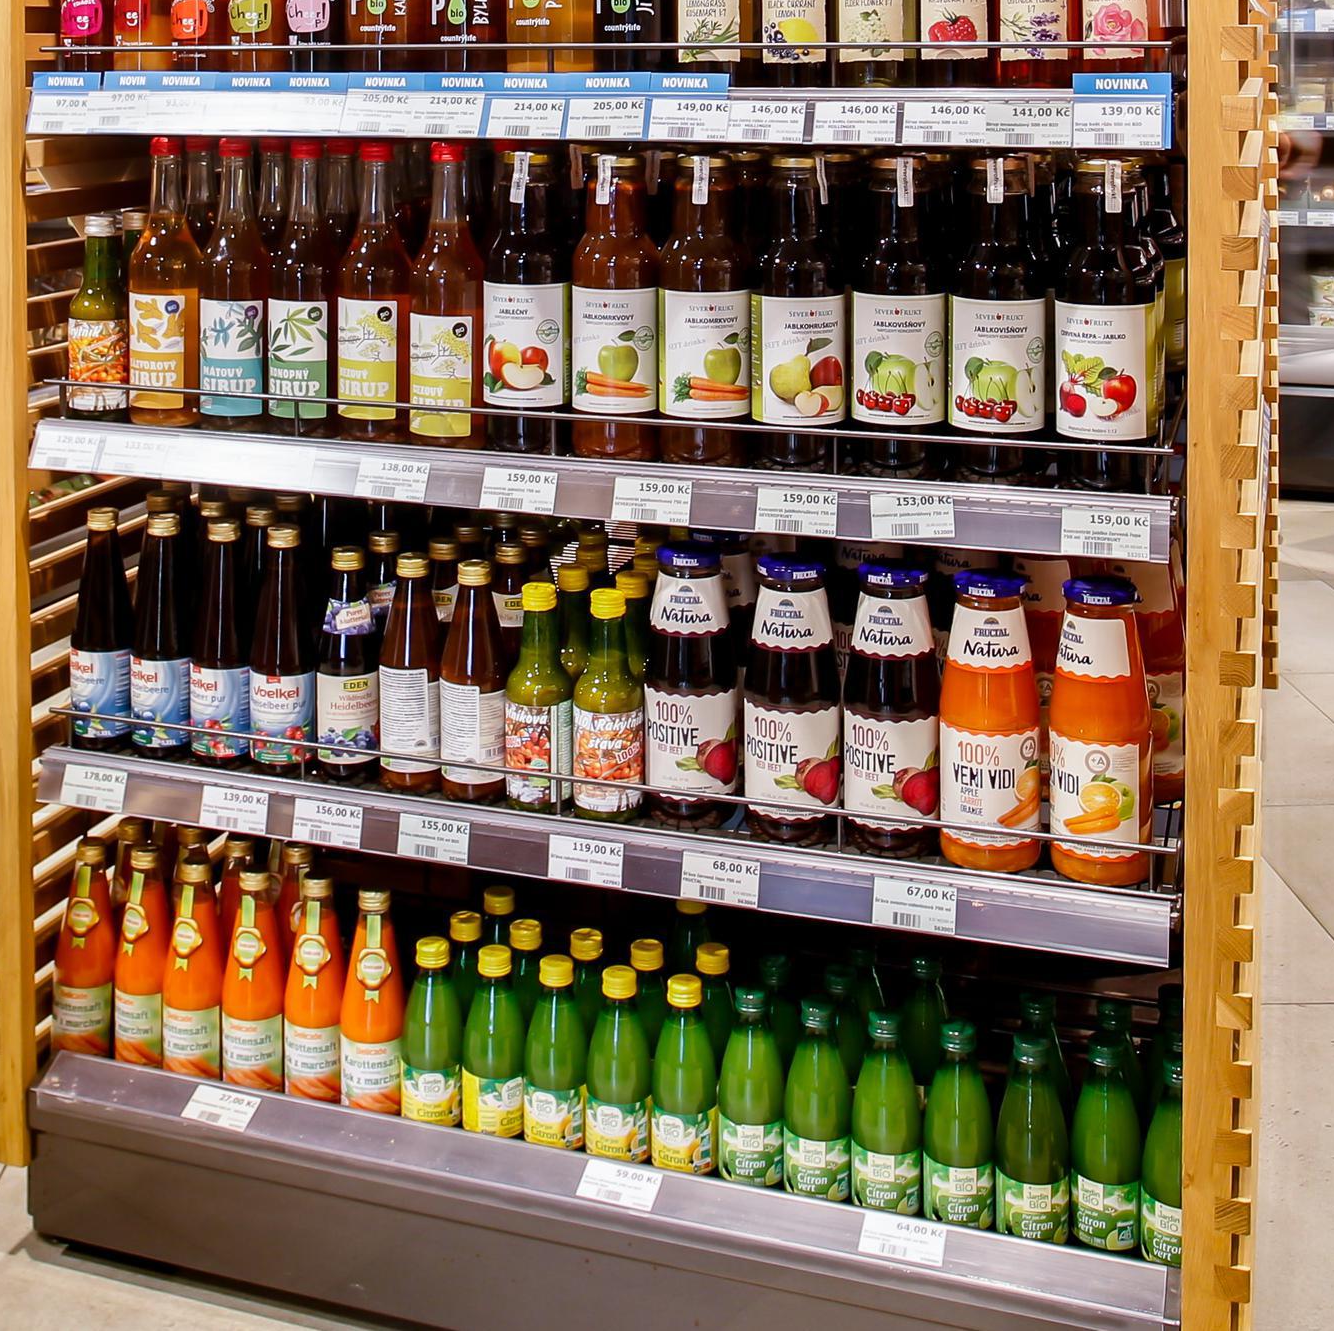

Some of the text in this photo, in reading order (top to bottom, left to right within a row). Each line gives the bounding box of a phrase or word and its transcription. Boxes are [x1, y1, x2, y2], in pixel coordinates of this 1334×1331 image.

[767, 0, 815, 9] BLACK CURRANT
[775, 9, 796, 18] LEMON
[585, 78, 630, 88] NOVINKA
[1095, 78, 1149, 90] NOVINKA
[593, 100, 644, 111] 205,00 Kč
[677, 102, 729, 112] 149,00 Kč
[1012, 107, 1070, 118] 141,00 Kč
[684, 316, 738, 326] JABLKOMRKVOVÝ
[973, 323, 1028, 335] JABLKOVIŠŇOVÝ
[202, 378, 257, 394] SIRUP
[269, 380, 321, 397] SIRUP
[639, 483, 690, 495] 159,00 Kč
[896, 494, 952, 507] 153,00 Kč
[669, 595, 703, 605] FRUCTAL
[661, 606, 713, 624] Natura
[973, 627, 1009, 638] FRUCTAL
[963, 639, 1020, 658] Natura
[655, 700, 693, 726] 100%
[647, 717, 699, 747] POSITIVE
[658, 744, 683, 756] RED BEET
[958, 742, 1000, 768] 100%
[953, 763, 1015, 791] VENI VIDI
[960, 787, 979, 798] APPLE
[960, 794, 983, 808] CARROT
[960, 804, 984, 817] ORANGE
[712, 860, 759, 876] 68,00 Kč
[906, 886, 956, 902] 67,00 Kč
[947, 1201, 979, 1215] Citron
[947, 1211, 968, 1222] vert
[896, 1222, 944, 1239] 64,00 Kč
